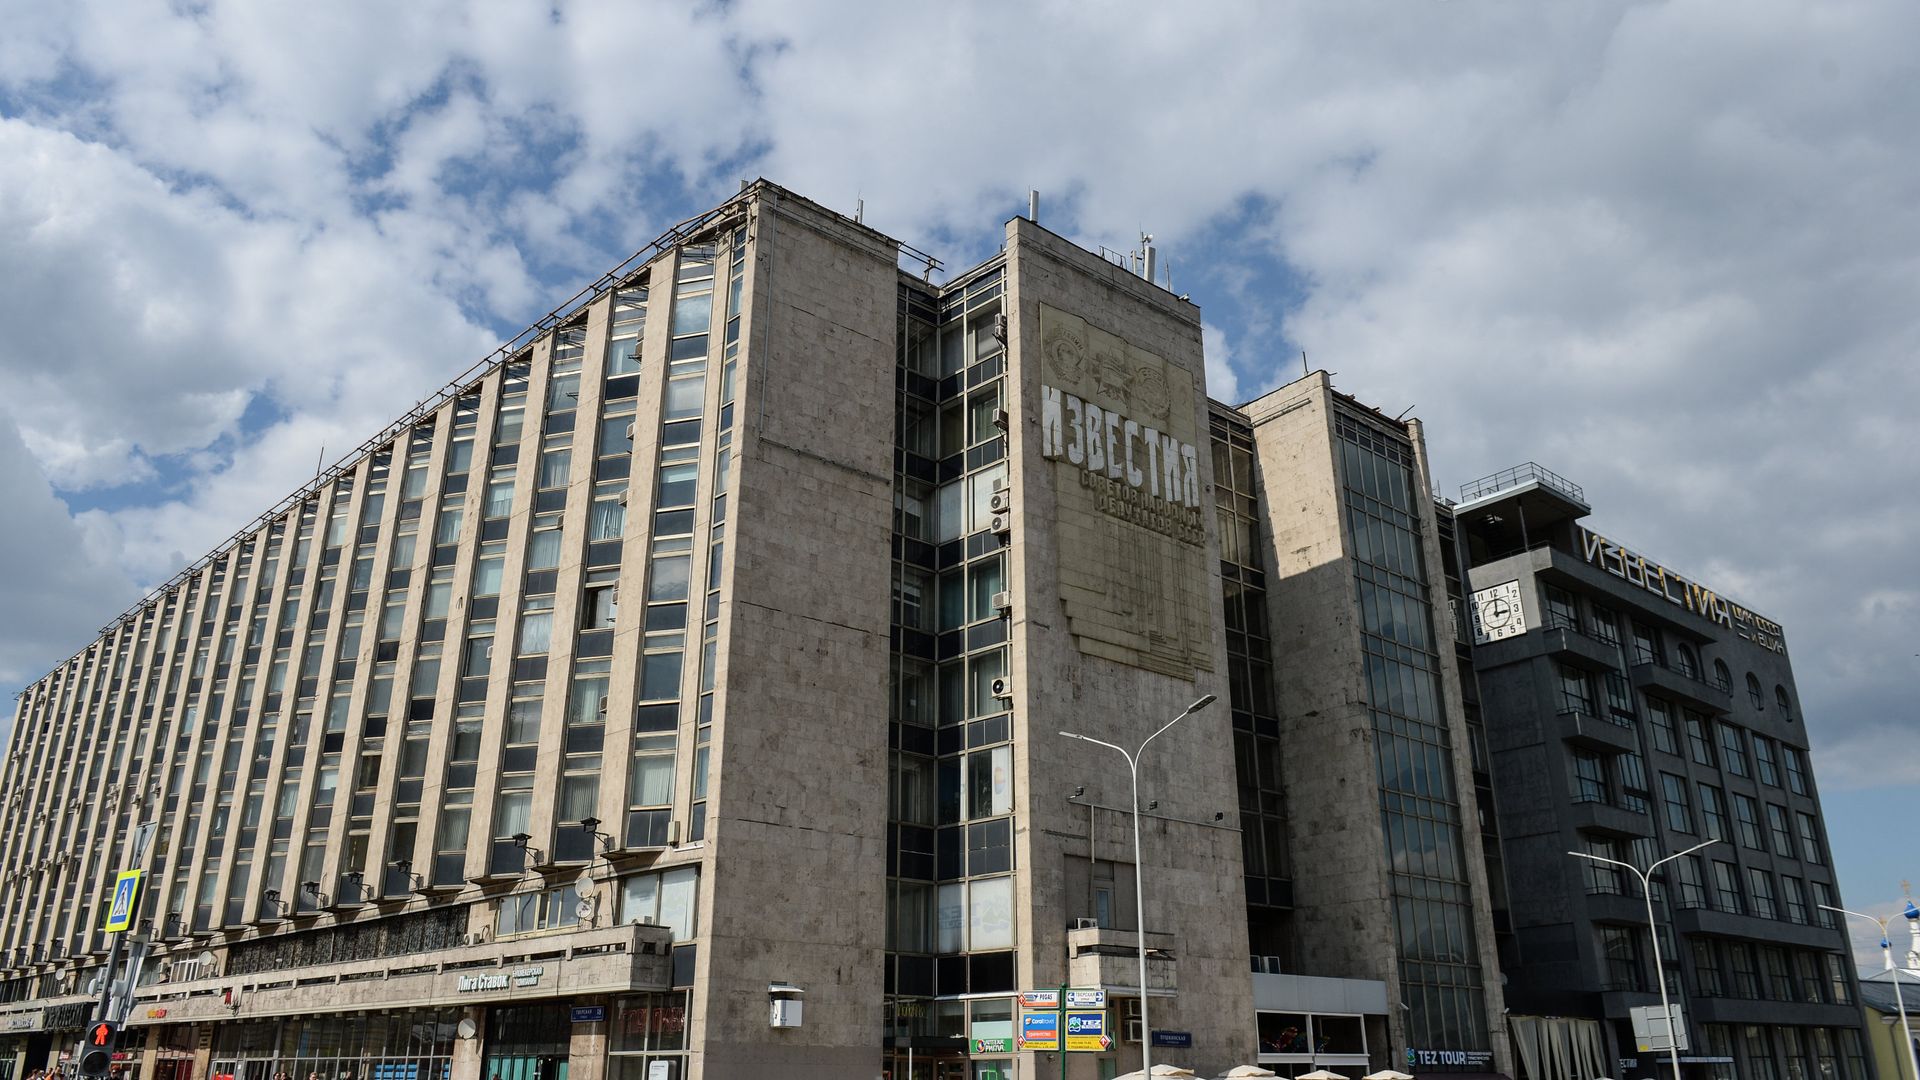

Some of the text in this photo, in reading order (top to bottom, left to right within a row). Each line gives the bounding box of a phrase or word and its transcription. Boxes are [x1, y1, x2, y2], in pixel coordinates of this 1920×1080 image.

[1042, 385, 1199, 508] ИЗВЕСТИЯ
[1081, 469, 1138, 502] СОВЕТОВ
[1099, 494, 1206, 544] ДЕПУТАТОВ СССР
[1580, 527, 1733, 629] ИЗВЕСТИЯ
[1489, 589, 1498, 598] 12
[1511, 589, 1518, 598] 2
[1471, 601, 1479, 610] 10
[1513, 604, 1519, 612] 3
[1474, 615, 1480, 623] 9
[1516, 618, 1522, 626] 4
[1477, 627, 1483, 636] 8
[1497, 629, 1503, 637] 6
[1510, 625, 1516, 633] 5
[1485, 632, 1490, 640] 7
[457, 973, 509, 991] Лига Ставок
[1417, 1050, 1467, 1065] TEZ TOUR
